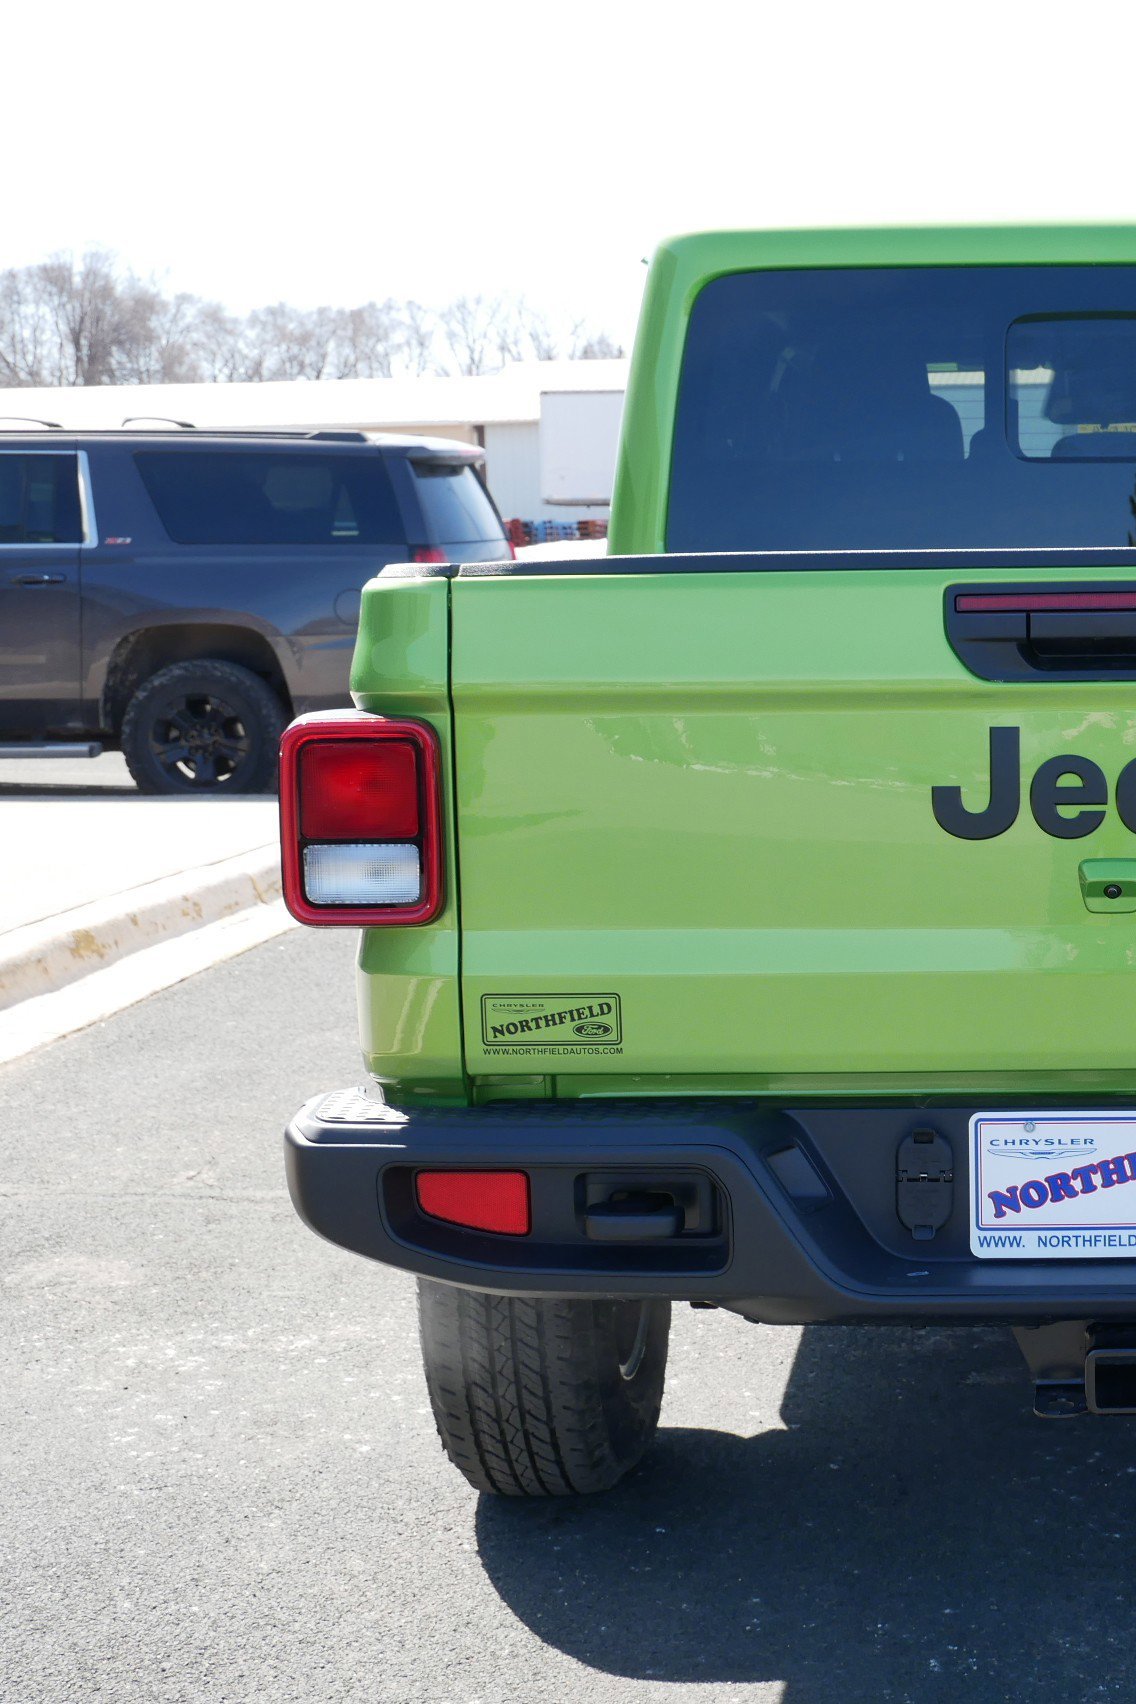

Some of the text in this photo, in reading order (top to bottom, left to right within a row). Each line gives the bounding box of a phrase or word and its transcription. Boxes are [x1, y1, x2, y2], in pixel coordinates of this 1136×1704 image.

[490, 1002, 612, 1038] NORTHFIELD
[483, 1047, 623, 1055] WWW.NORTHFIELDAUTOS.COM
[989, 1138, 1094, 1146] CHRYSLER
[978, 1235, 1026, 1248] WWW.
